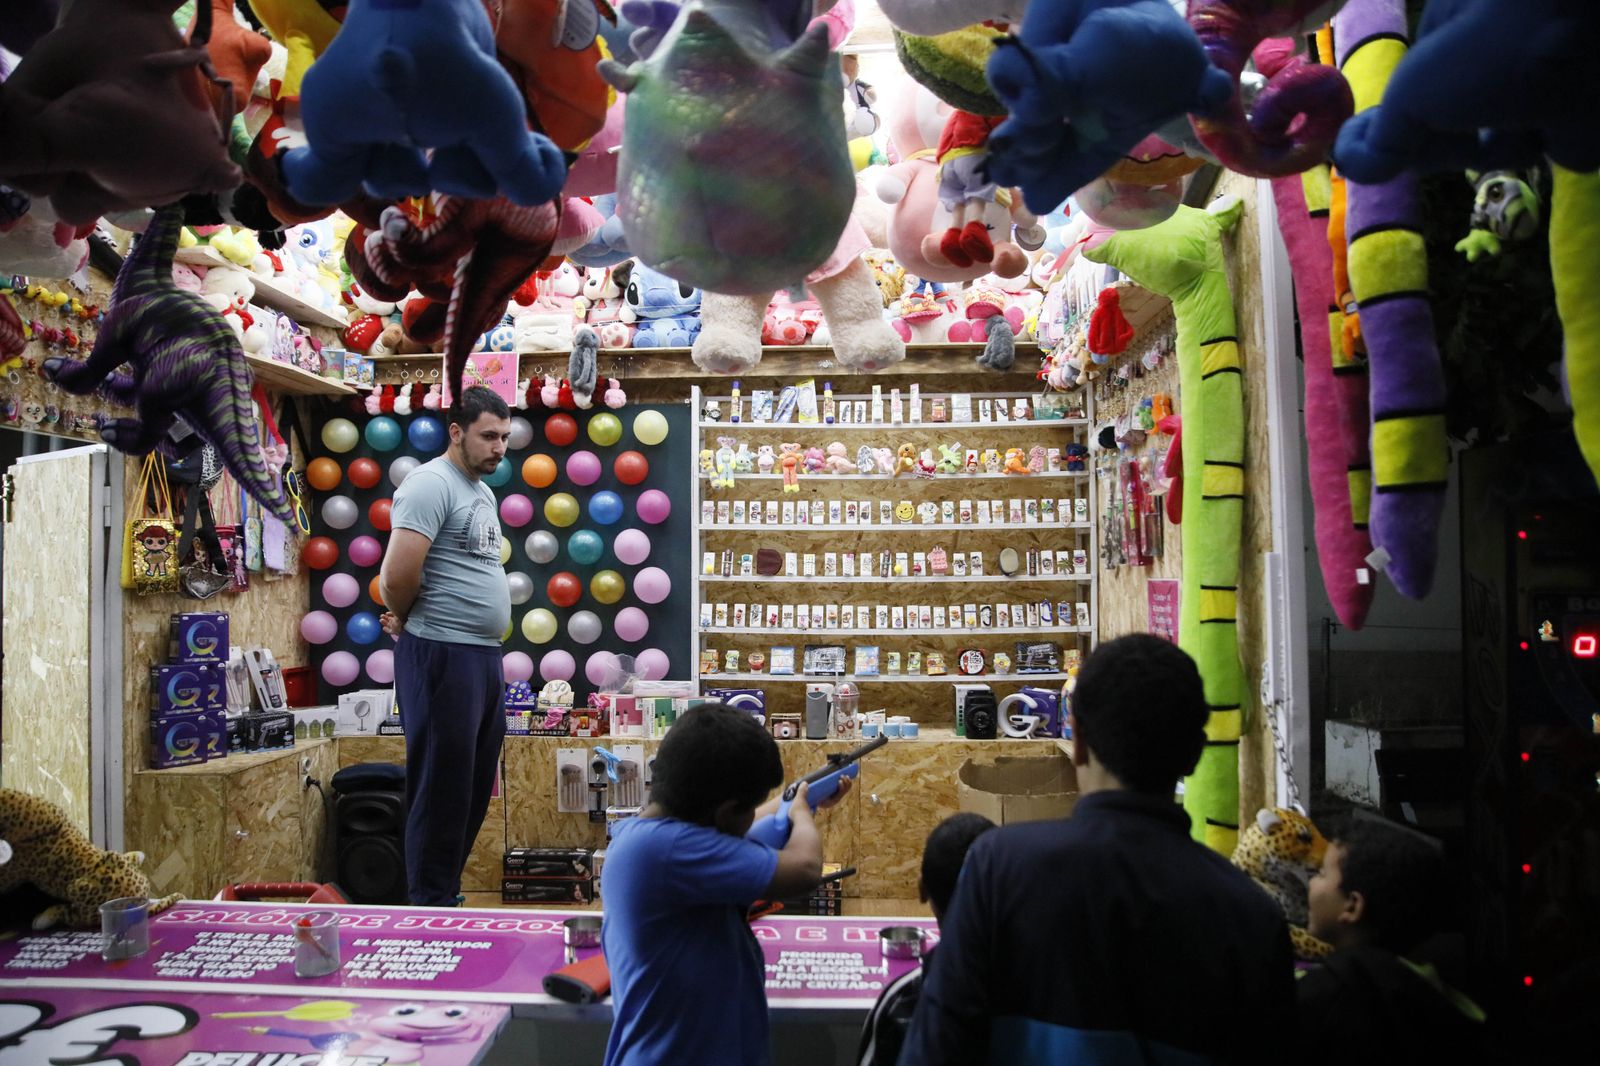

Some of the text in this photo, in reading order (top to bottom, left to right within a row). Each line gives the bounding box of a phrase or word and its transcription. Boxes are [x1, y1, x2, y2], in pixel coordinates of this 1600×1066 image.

[208, 939, 232, 947] NO
[371, 939, 424, 948] MISMO
[424, 940, 494, 950] JUGADOR
[243, 948, 292, 957] GLOBO
[377, 946, 402, 955] NO
[194, 954, 233, 962] CAER
[353, 953, 430, 963] LLEVARSE
[781, 951, 864, 960] PROHIBIDO
[203, 962, 254, 971] GLOBO
[251, 963, 279, 972] NO
[343, 961, 368, 970] DE
[380, 962, 459, 973] PELUCHES
[778, 959, 865, 967] ACERCARSE
[786, 965, 808, 973] LA
[347, 969, 440, 981] POR NOCHE
[776, 973, 864, 981] PROHIBIDO
[764, 980, 884, 990] IRAR CRUZADO
